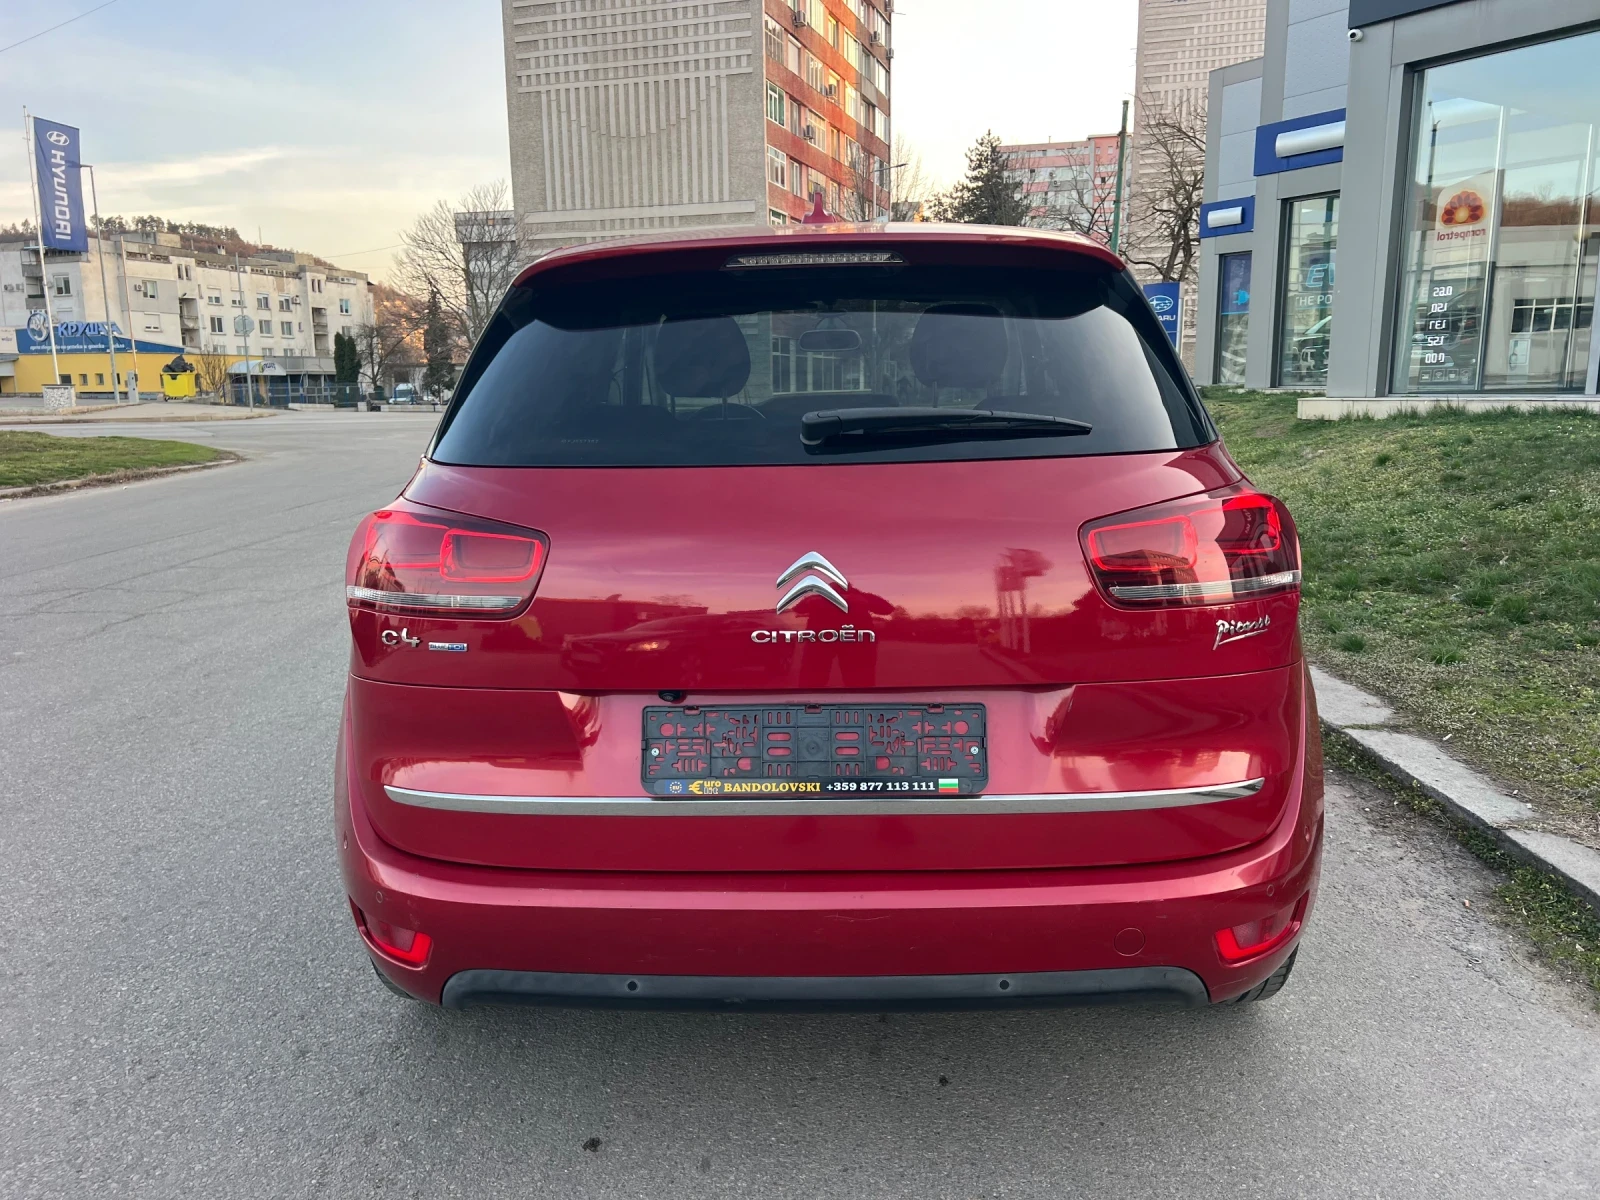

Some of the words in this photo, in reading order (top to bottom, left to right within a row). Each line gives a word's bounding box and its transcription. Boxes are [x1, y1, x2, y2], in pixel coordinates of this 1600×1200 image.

[51, 149, 72, 240] HYUNDAI
[1317, 294, 1333, 305] PO
[381, 627, 421, 648] C4
[750, 624, 876, 643] CITROËN
[1212, 614, 1271, 650] Picasso
[723, 782, 821, 792] BANDOLOVSKI
[826, 781, 857, 791] +359
[859, 781, 883, 791] 877
[886, 781, 909, 791] 113
[912, 781, 935, 791] 111
